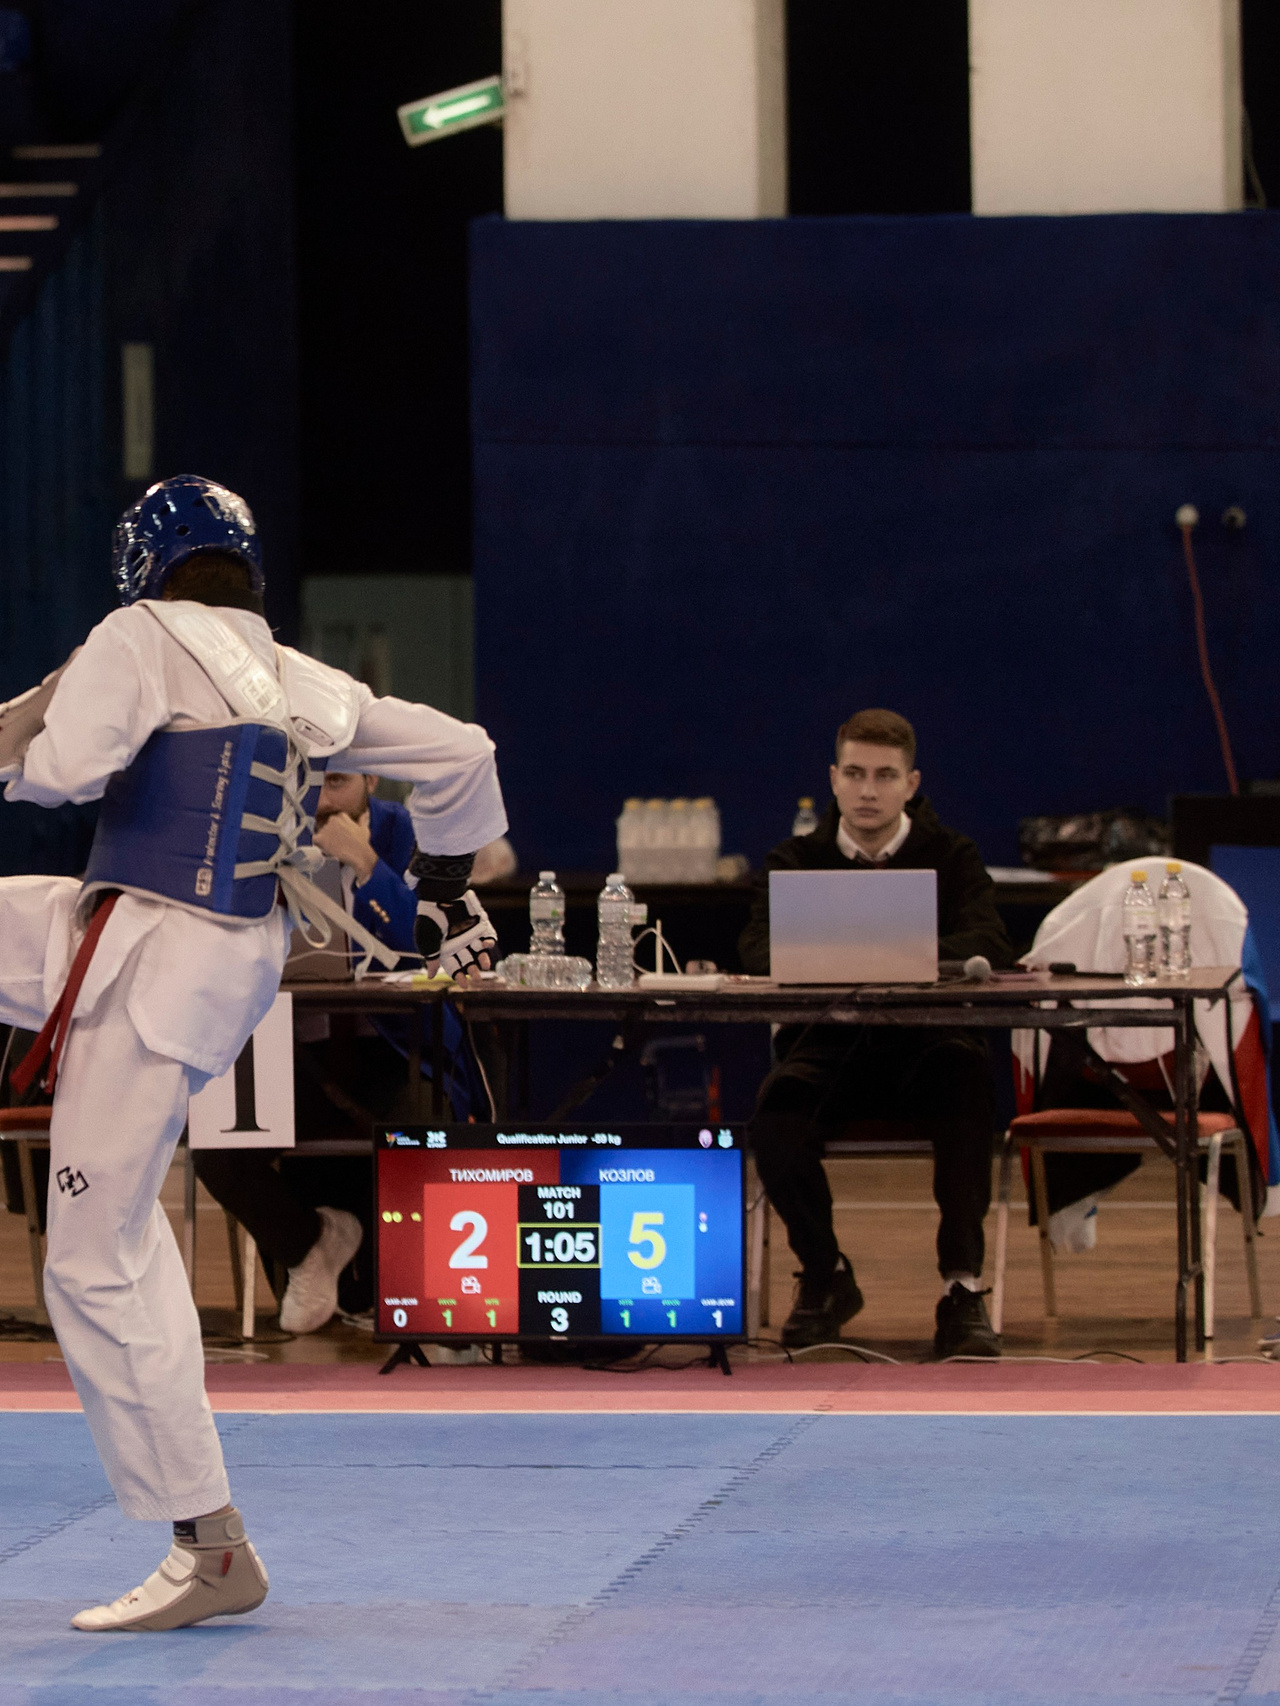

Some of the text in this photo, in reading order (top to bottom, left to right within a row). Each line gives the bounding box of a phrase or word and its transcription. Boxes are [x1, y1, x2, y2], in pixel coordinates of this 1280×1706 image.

[496, 1132, 556, 1145] Qualification
[557, 1132, 588, 1145] Junior
[608, 1132, 622, 1146] kg
[449, 1168, 534, 1182] ТИХОМИРОВ
[599, 1168, 655, 1182] КОЗЛОВ
[537, 1187, 581, 1199] MATCH
[543, 1201, 575, 1219] 101
[449, 1211, 488, 1269] 2
[525, 1231, 596, 1262] 1:05
[627, 1212, 667, 1270] 5
[537, 1291, 582, 1304] ROUND
[393, 1309, 408, 1328] 0
[441, 1309, 452, 1328] 1
[486, 1309, 496, 1328] 1
[550, 1307, 569, 1332] 3
[619, 1309, 630, 1328] 1
[666, 1309, 677, 1328] 1
[711, 1309, 723, 1328] 1
